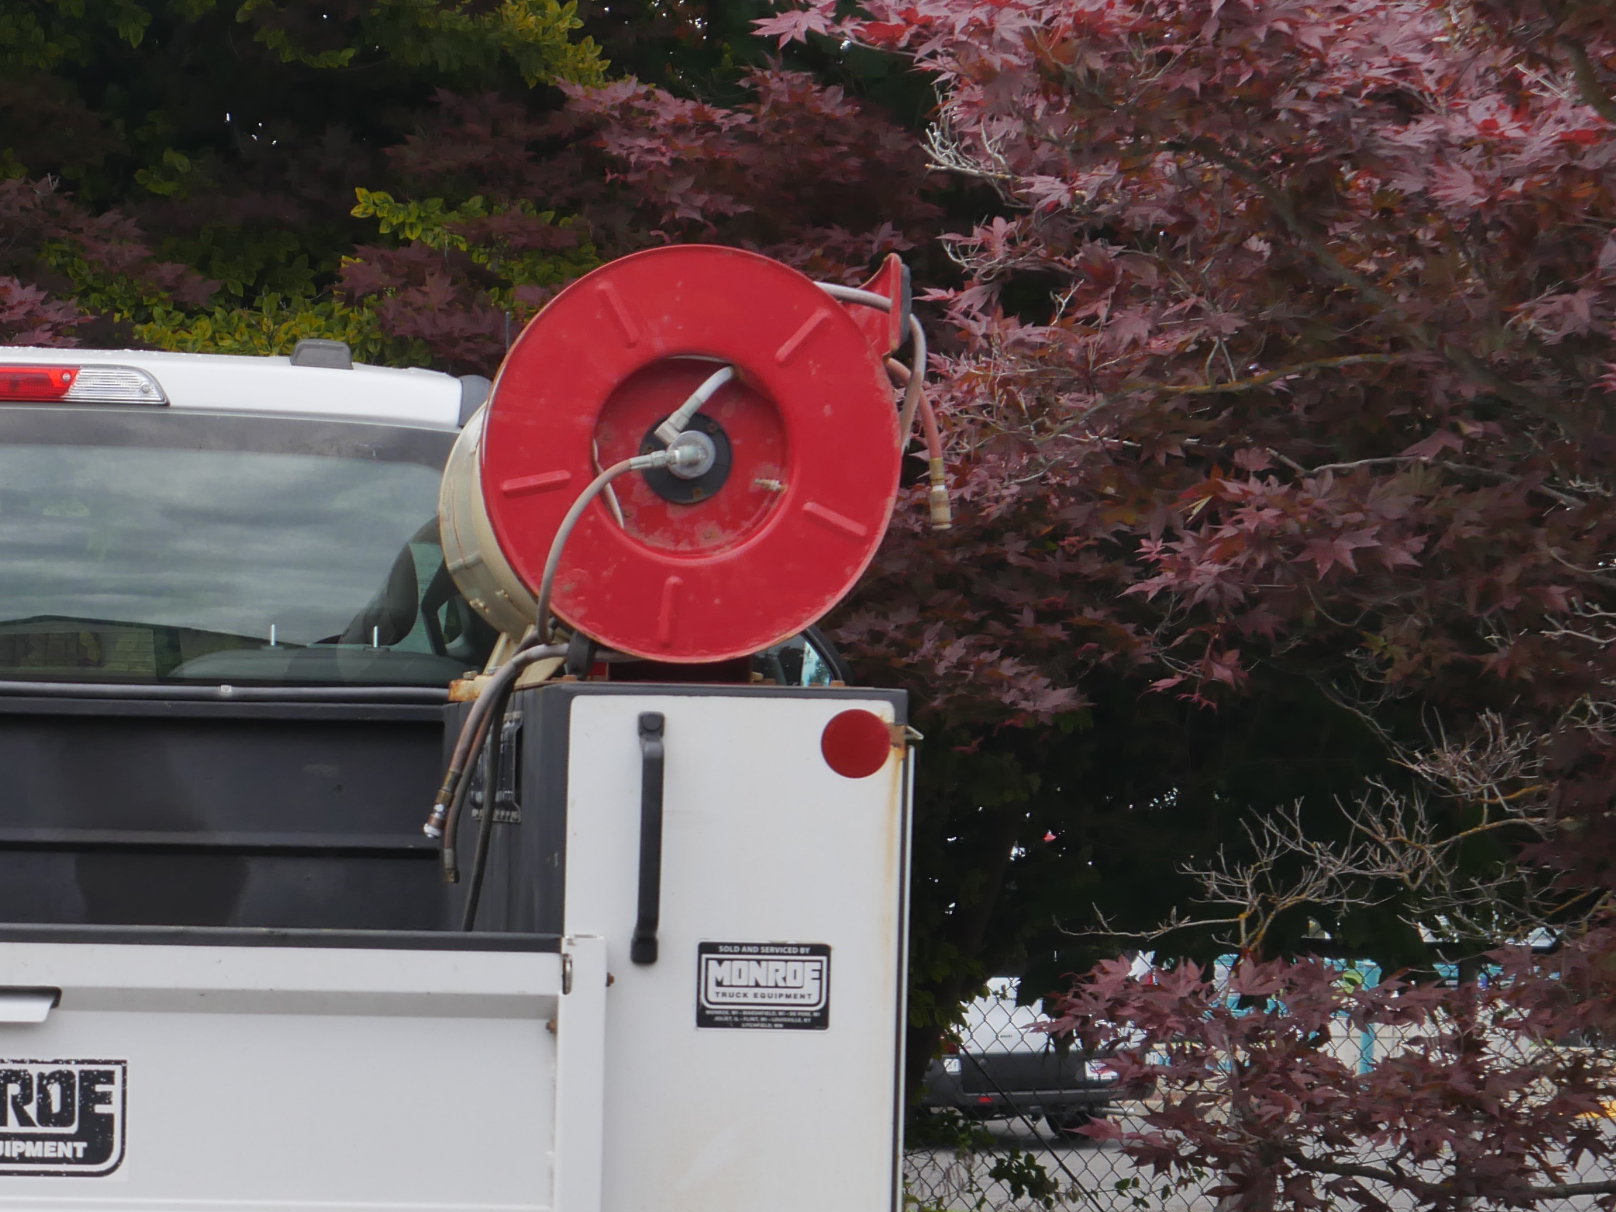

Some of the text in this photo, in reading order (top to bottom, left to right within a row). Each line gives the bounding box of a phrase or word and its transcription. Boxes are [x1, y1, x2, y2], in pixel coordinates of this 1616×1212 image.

[718, 945, 811, 954] SOLD AND SERVICED BY
[707, 959, 821, 988] MONROE
[715, 991, 813, 1000] TRUCK EQUIPMENT
